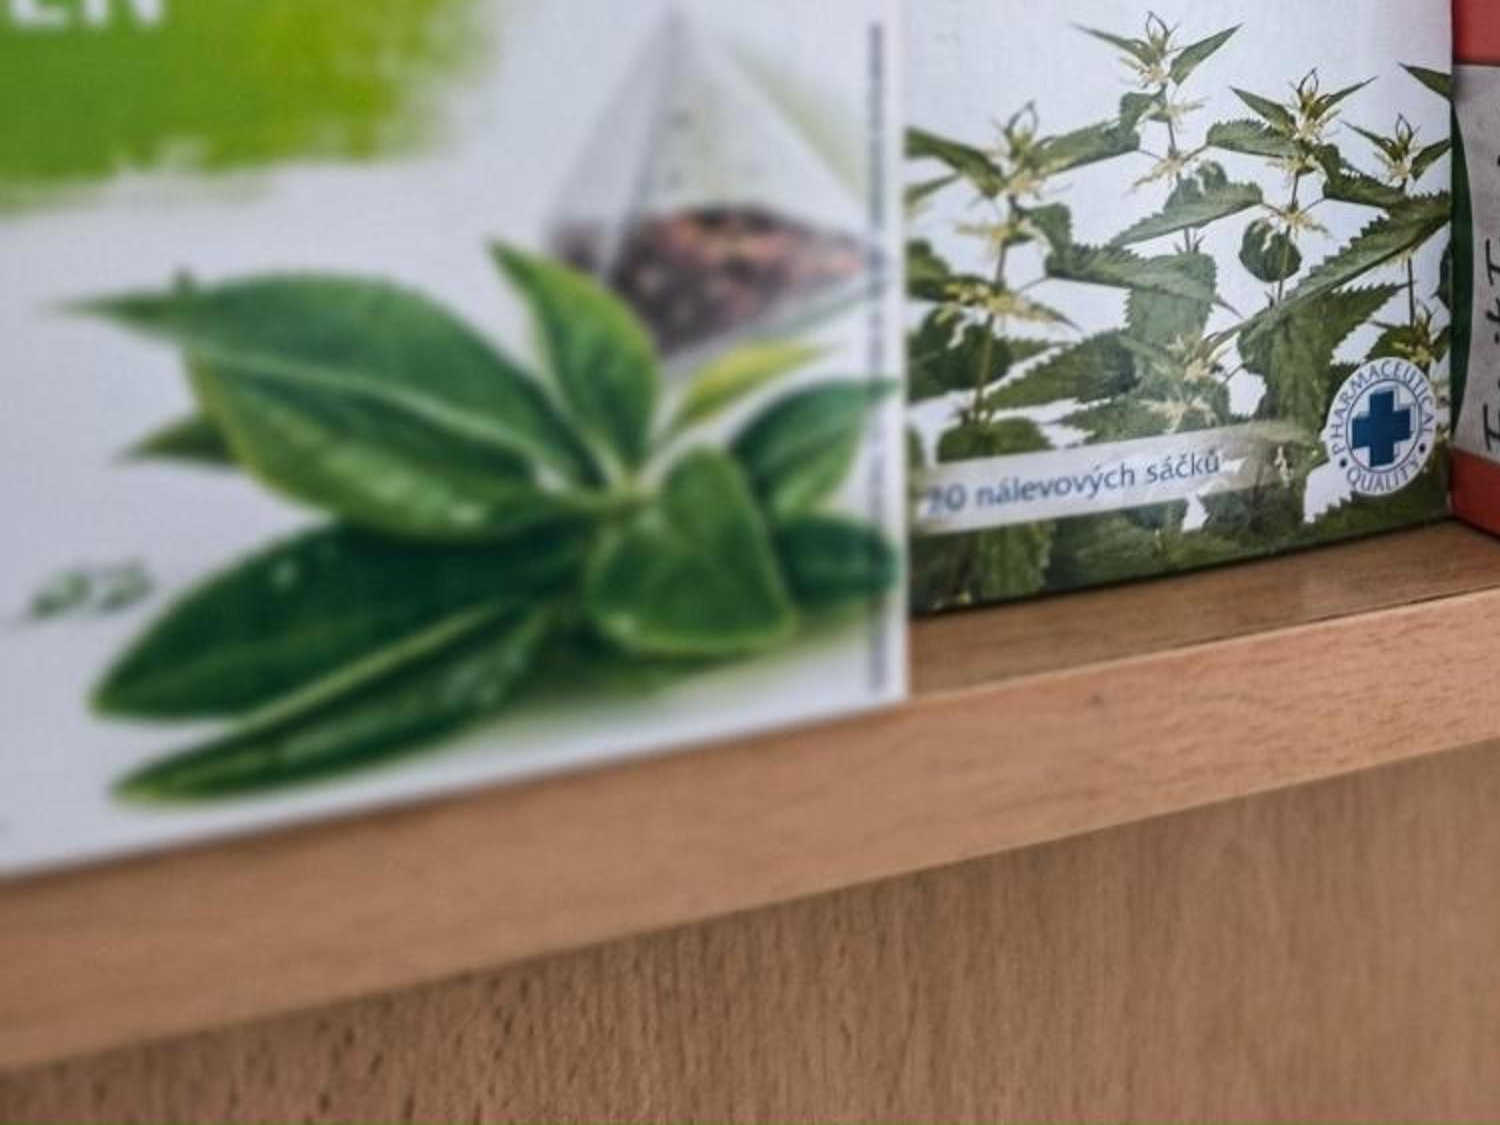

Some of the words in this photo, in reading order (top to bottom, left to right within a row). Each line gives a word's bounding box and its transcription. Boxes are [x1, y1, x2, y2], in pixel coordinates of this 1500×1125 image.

[1330, 359, 1435, 456] PHARMACEUTICAL
[976, 463, 1136, 507] nálevových
[1146, 448, 1221, 485] sáčků
[1345, 454, 1420, 492] QUALITY
